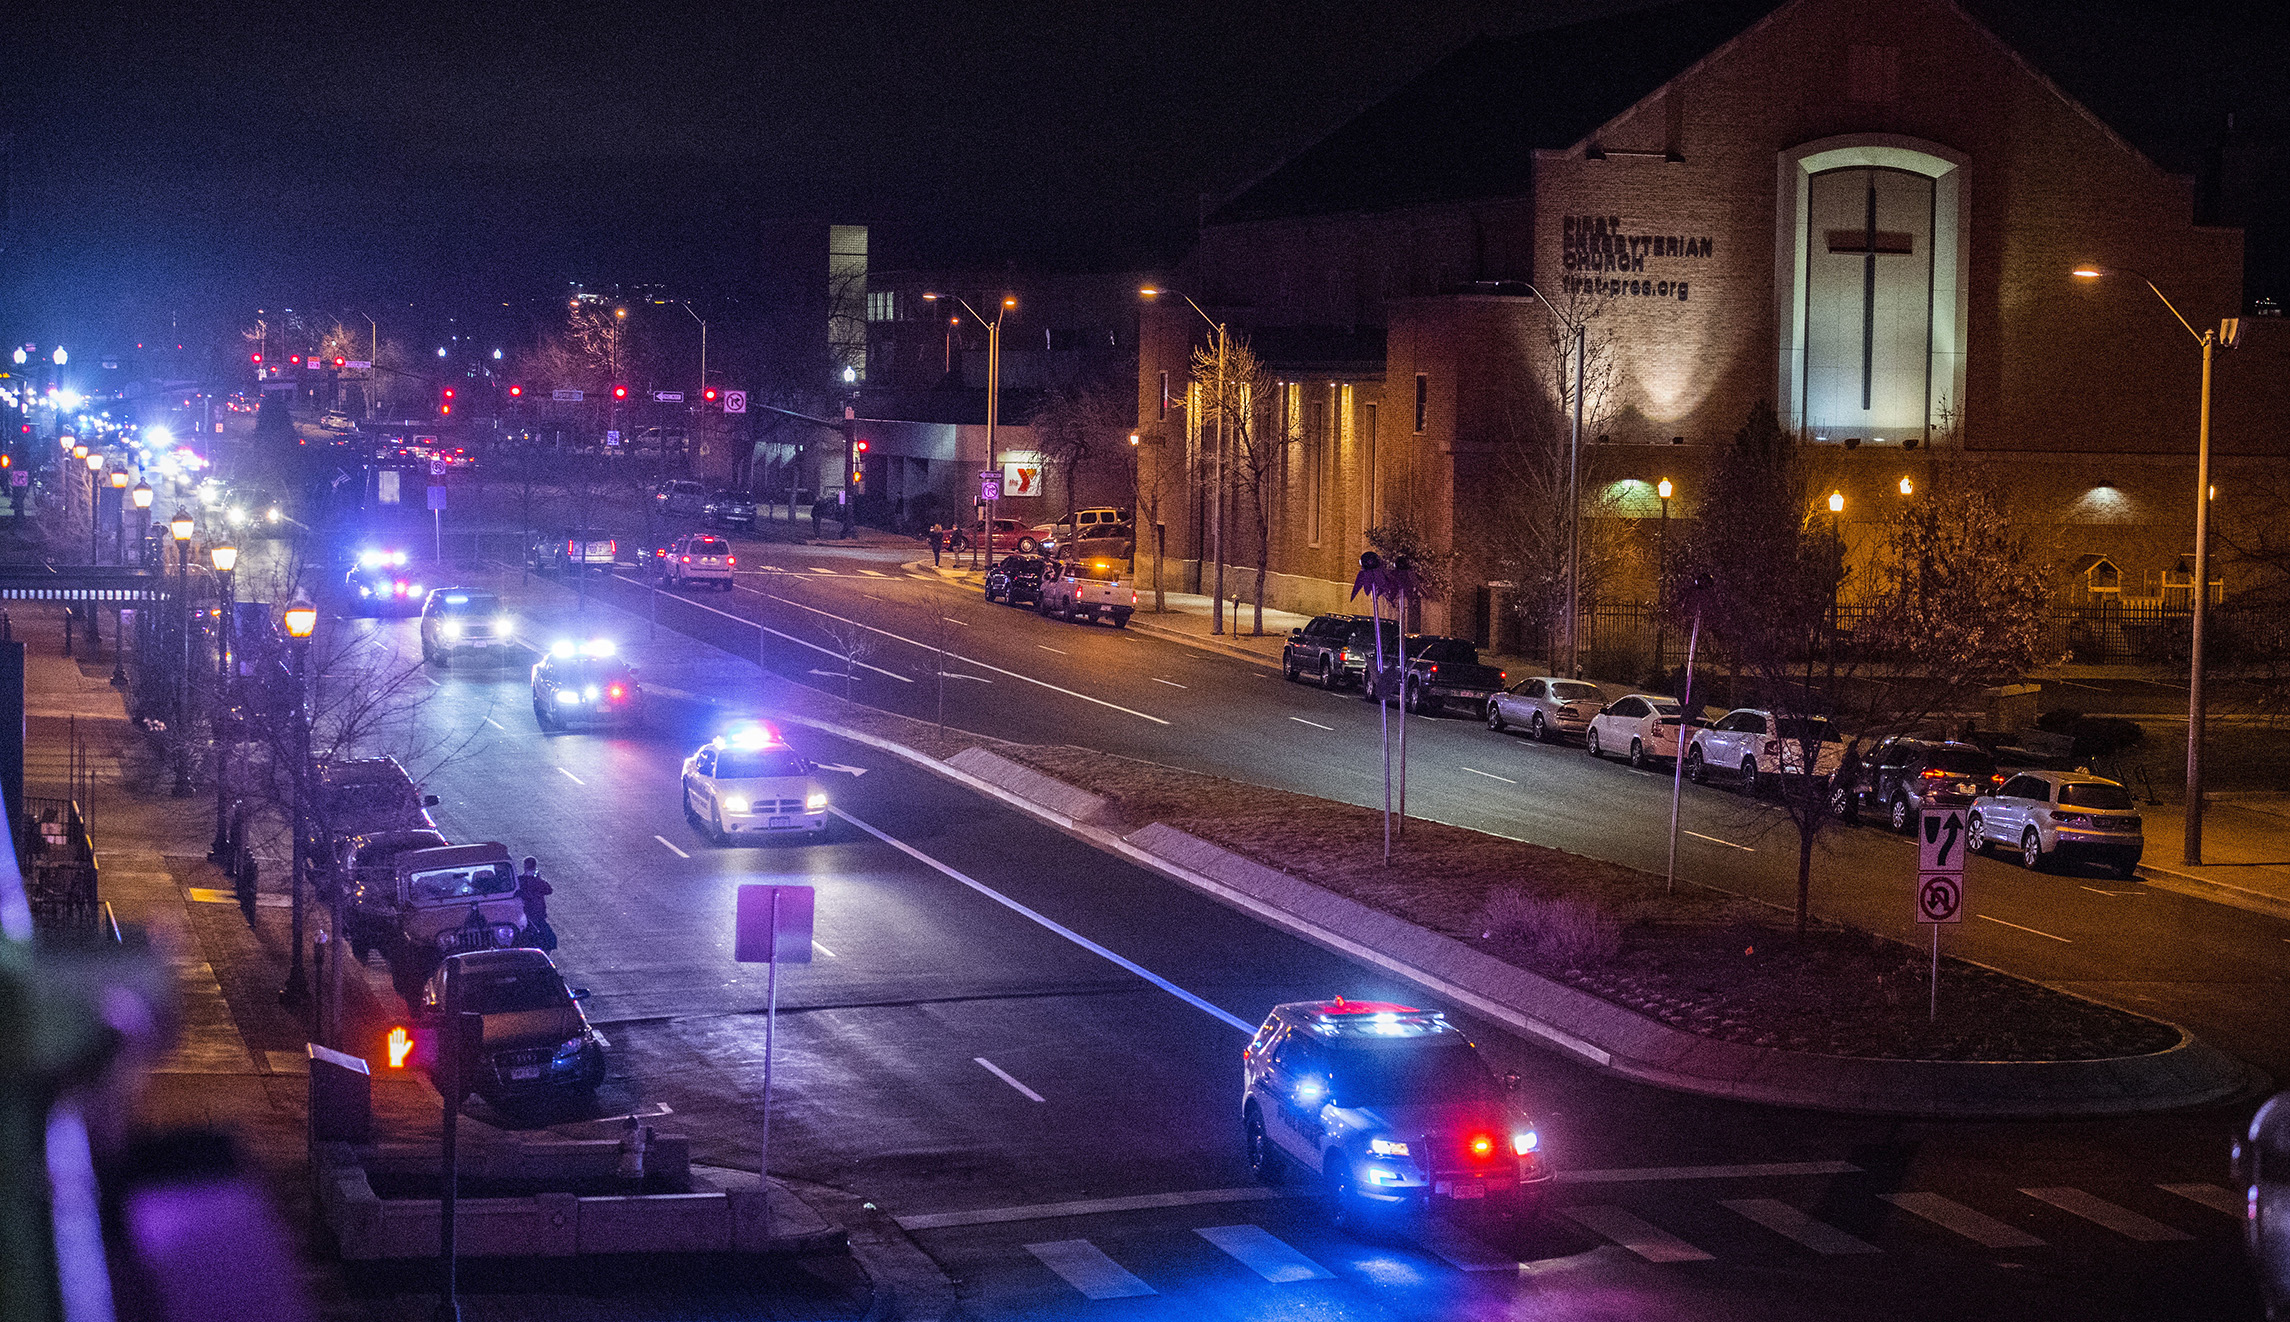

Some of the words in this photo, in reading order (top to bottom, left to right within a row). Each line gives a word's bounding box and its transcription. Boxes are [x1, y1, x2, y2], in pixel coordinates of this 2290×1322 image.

[1563, 216, 1620, 236] FIRST
[1563, 234, 1713, 257] PRESBYTERIAN
[1563, 251, 1644, 272] CHURCH
